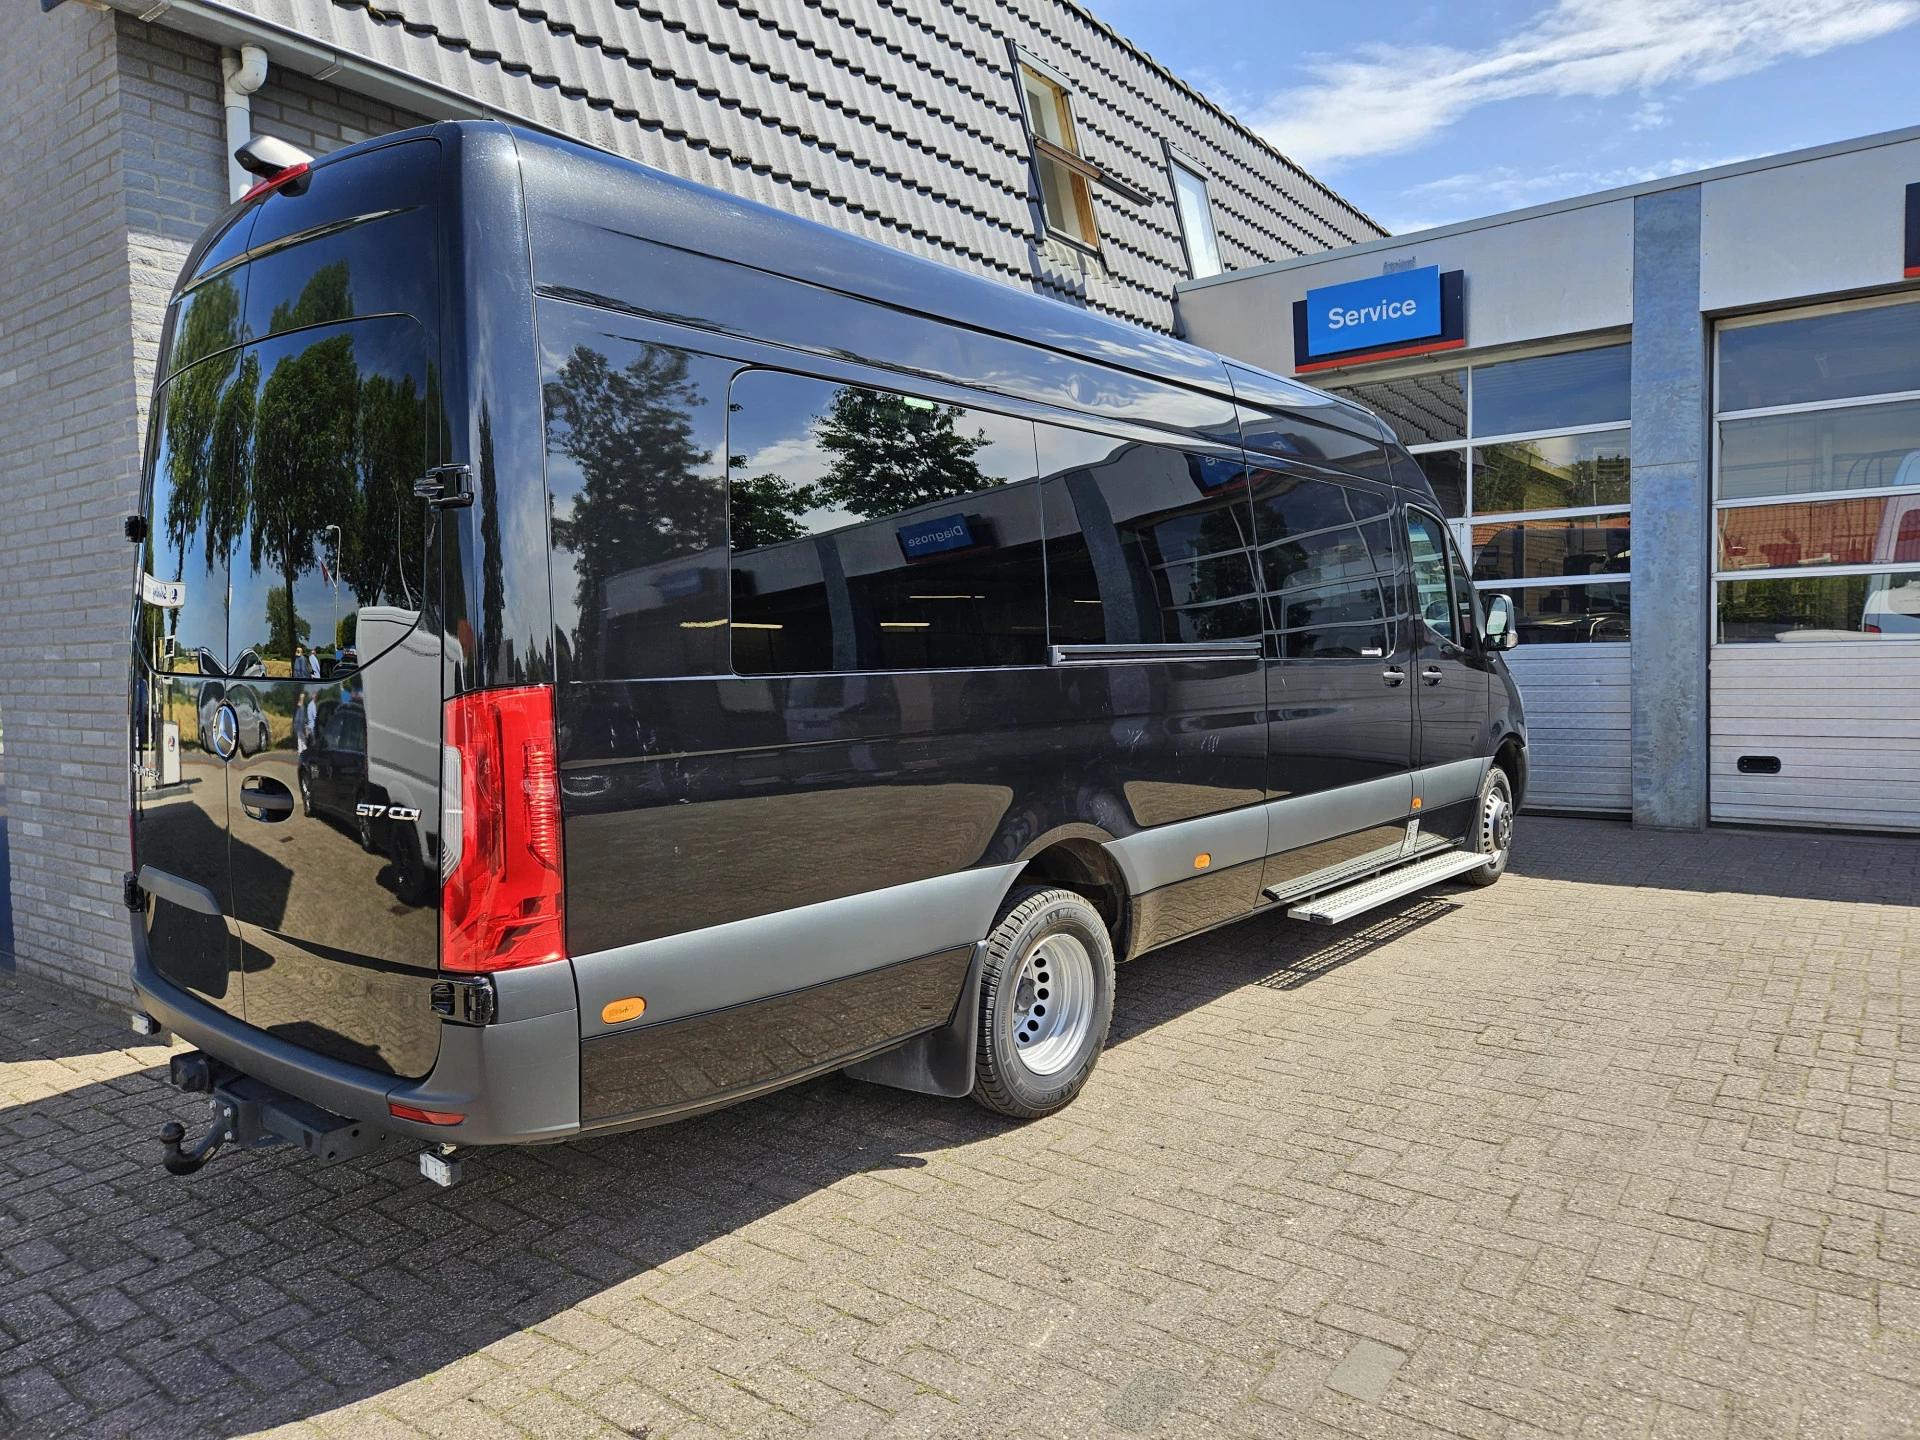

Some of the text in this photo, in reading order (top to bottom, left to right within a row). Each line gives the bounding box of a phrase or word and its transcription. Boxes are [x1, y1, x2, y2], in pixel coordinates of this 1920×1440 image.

[1328, 299, 1417, 330] Service
[356, 803, 422, 822] 517 CDI
